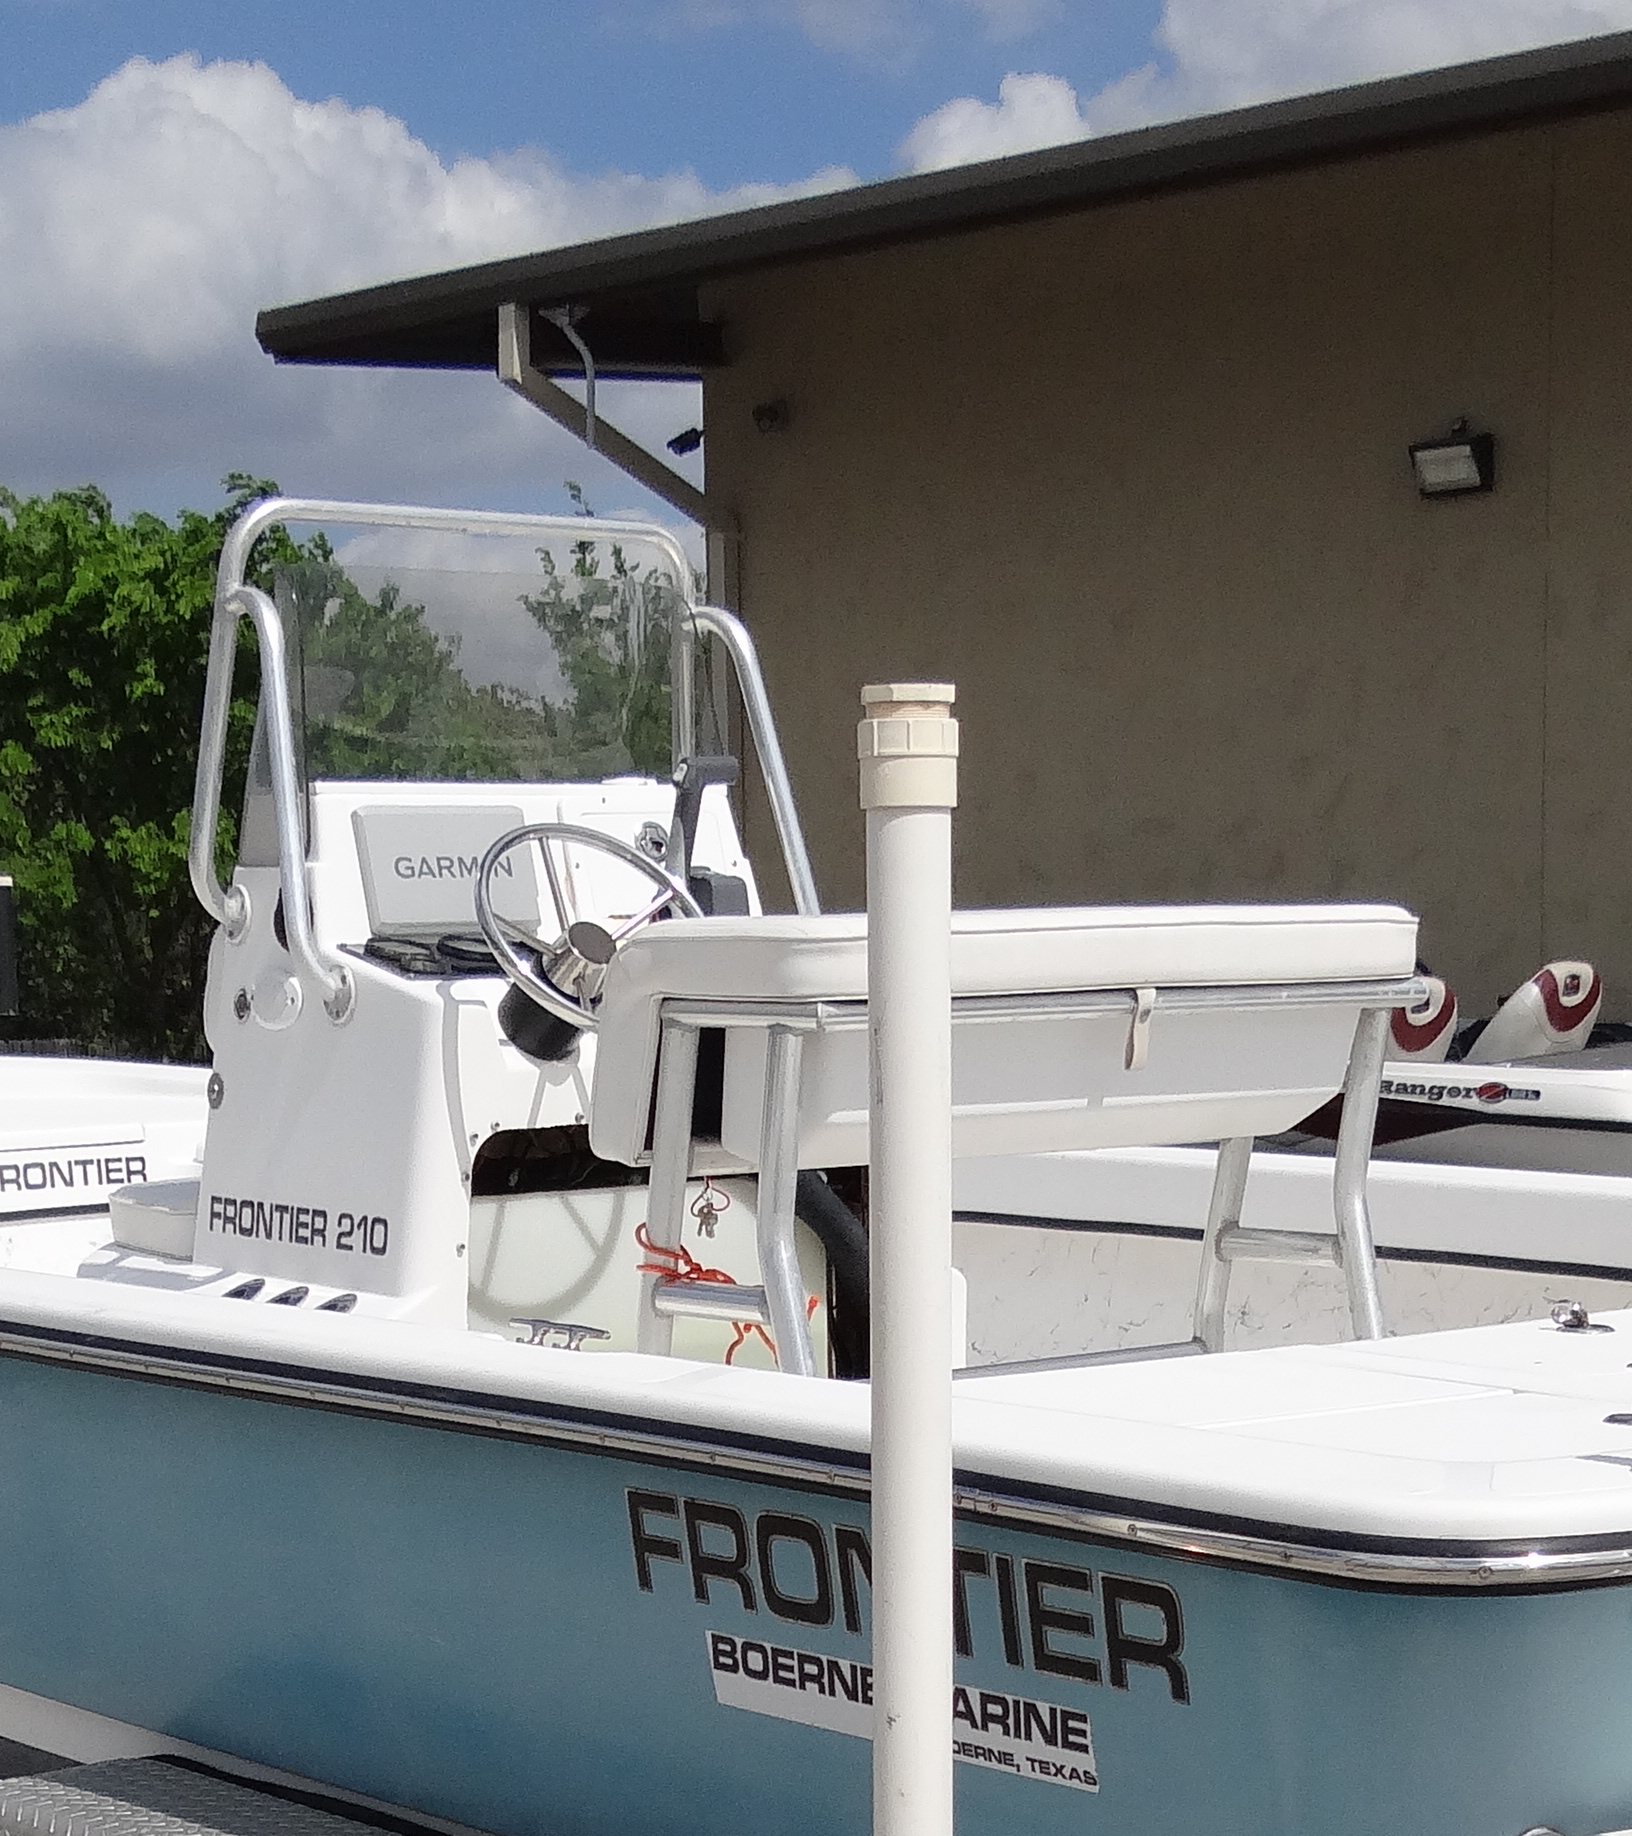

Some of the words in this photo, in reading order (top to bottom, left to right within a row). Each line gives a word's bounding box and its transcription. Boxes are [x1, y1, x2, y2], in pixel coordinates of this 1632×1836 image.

[394, 855, 514, 879] GARMN
[209, 1196, 327, 1248] FRONTIER
[336, 1212, 389, 1257] 210
[952, 1686, 1091, 1755] ARINE
[1026, 1756, 1098, 1786] TEXAS
